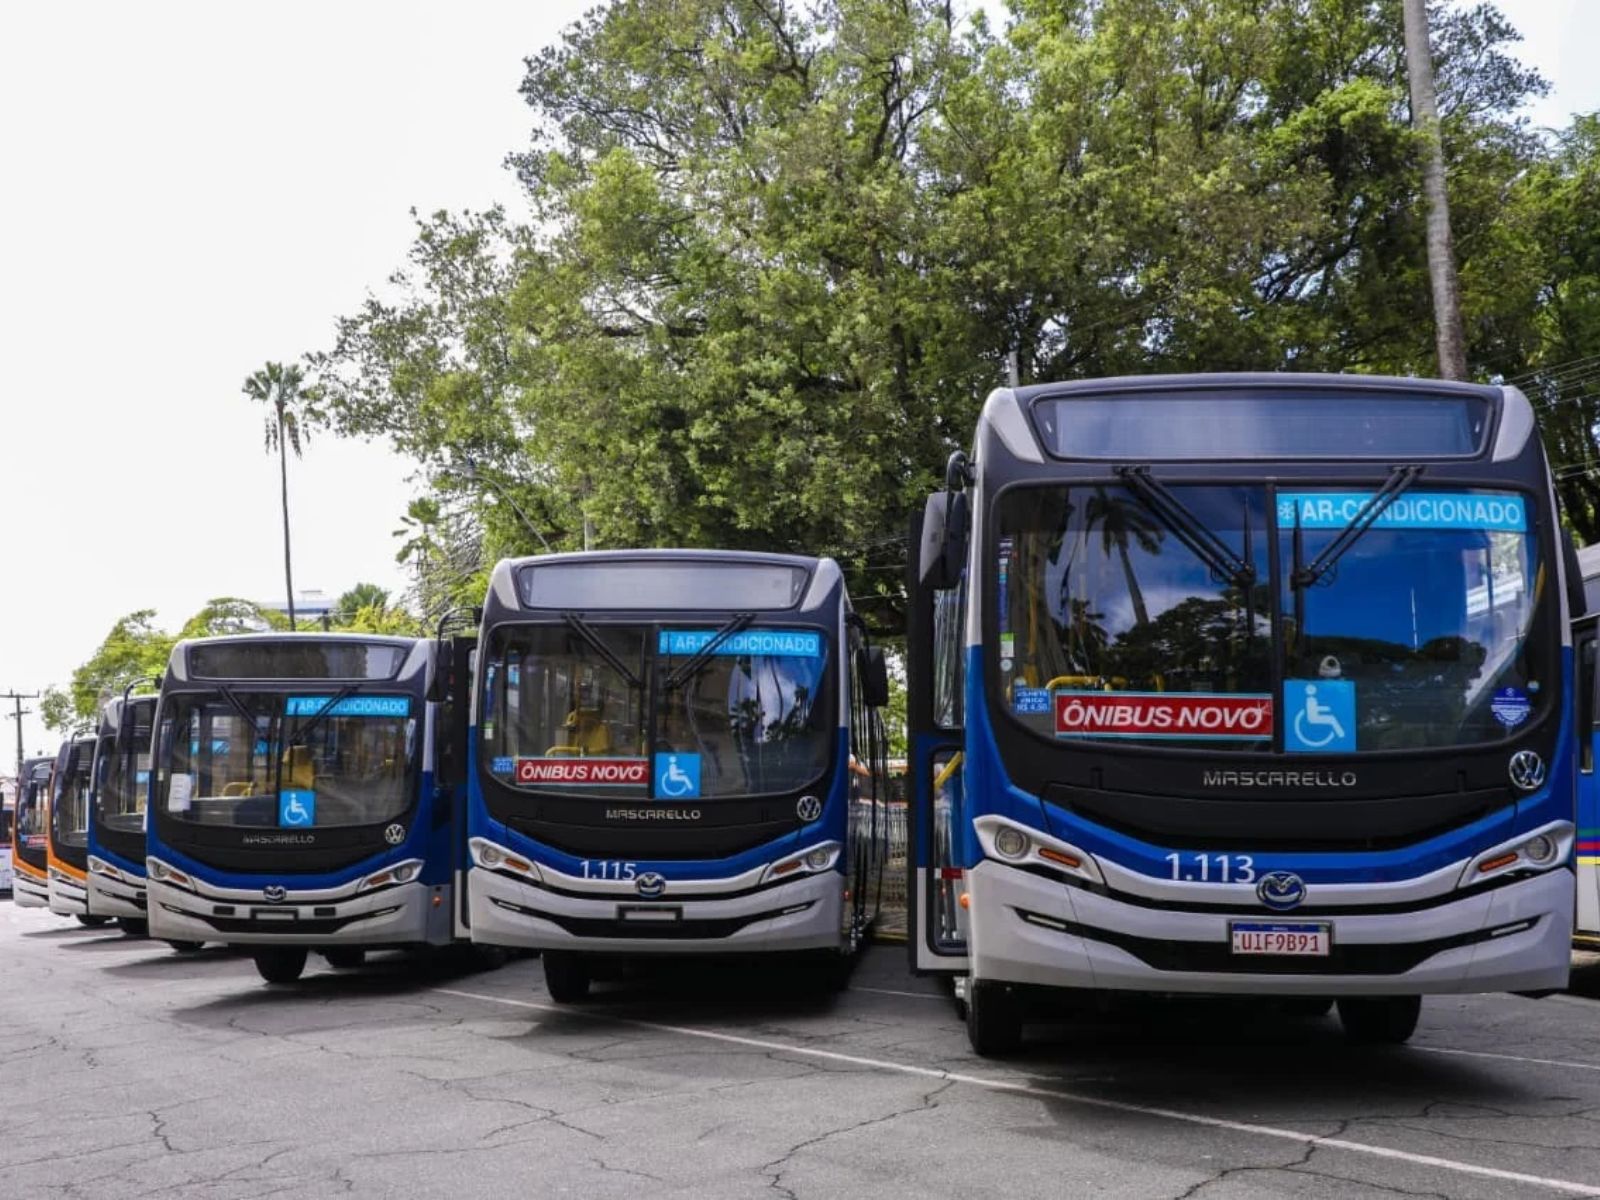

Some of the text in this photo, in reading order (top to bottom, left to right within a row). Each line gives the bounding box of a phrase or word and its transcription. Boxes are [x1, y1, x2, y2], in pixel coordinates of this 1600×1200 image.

[1063, 700, 1263, 729] ÔNIBUS NOVO
[521, 761, 588, 779] ÔNIBUS
[591, 766, 643, 780] NOVO
[1203, 771, 1357, 787] MASCARELLO
[606, 809, 701, 820] MASCARELLO
[580, 860, 637, 880] 1.115
[1165, 853, 1256, 883] 1.113
[1241, 933, 1319, 952] UIF9B91
